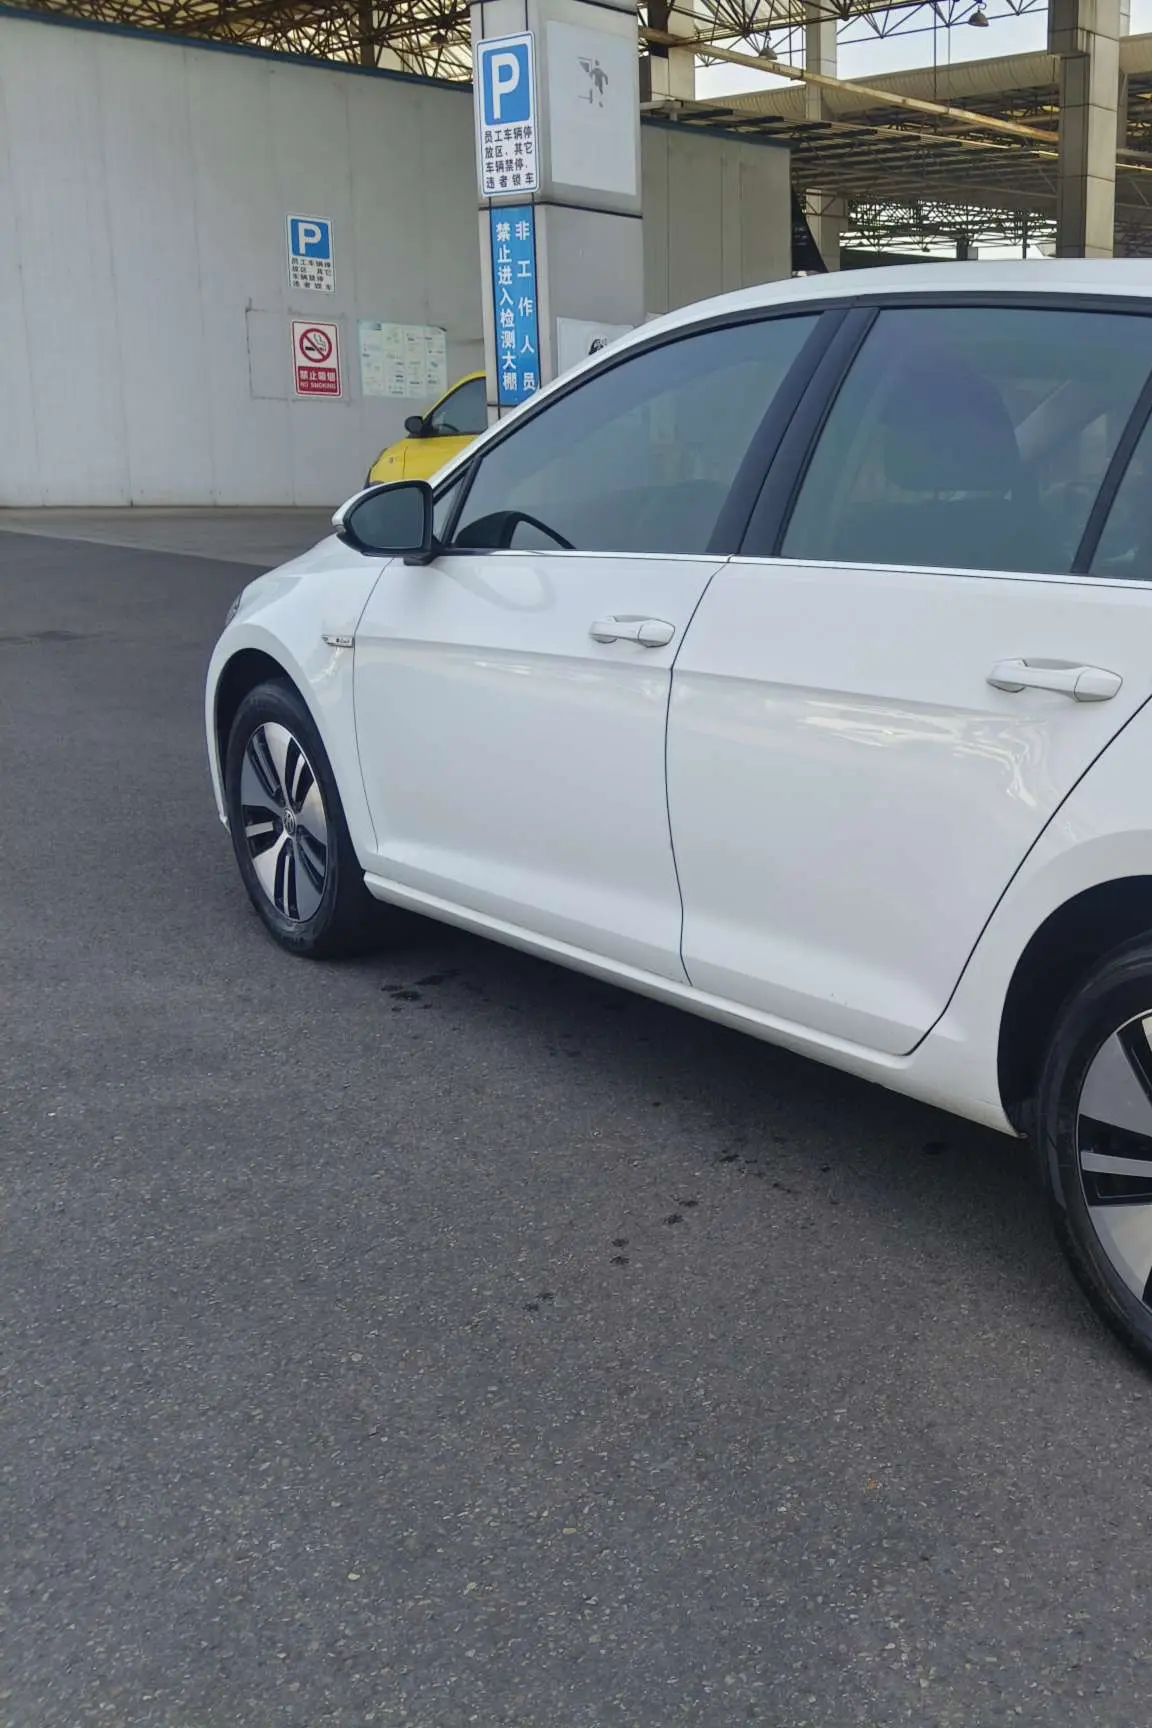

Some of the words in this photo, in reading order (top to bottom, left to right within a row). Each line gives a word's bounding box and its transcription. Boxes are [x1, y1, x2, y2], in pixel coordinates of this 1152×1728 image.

[491, 52, 520, 119] P
[484, 126, 533, 143] 员工车辆停
[298, 222, 322, 254] P
[496, 223, 518, 391] 禁止进入检测大棚
[515, 221, 536, 391] 非工作人员
